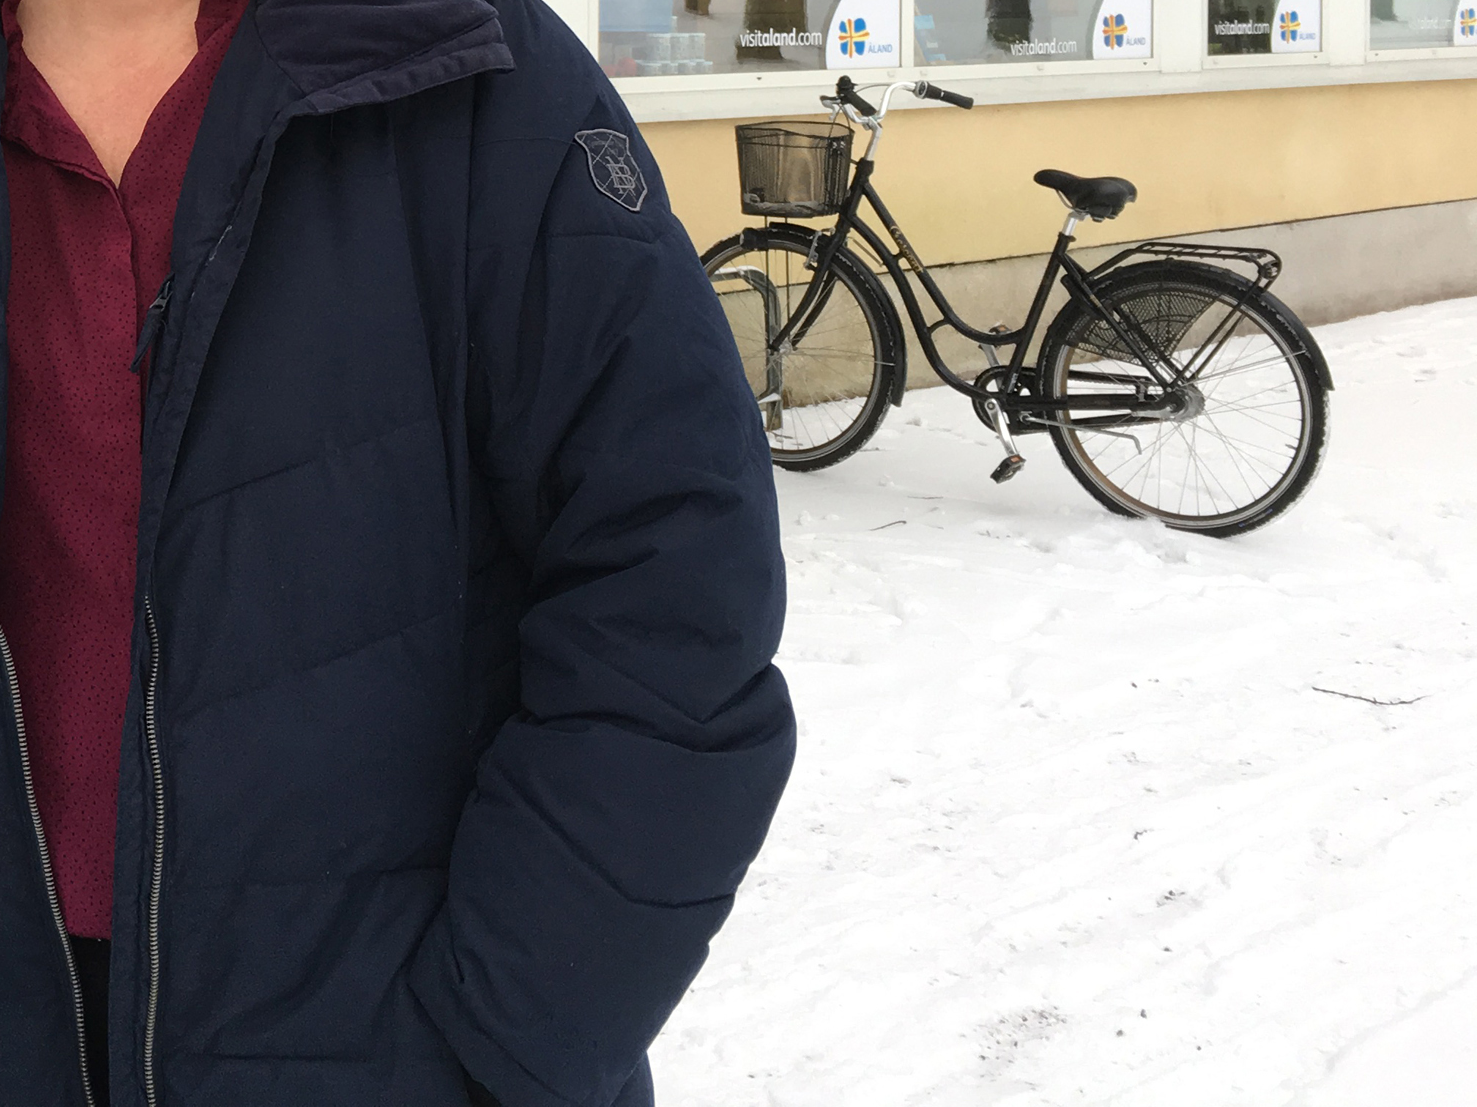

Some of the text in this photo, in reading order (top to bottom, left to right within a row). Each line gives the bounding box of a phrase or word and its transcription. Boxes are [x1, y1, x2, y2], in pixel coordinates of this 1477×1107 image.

[1214, 19, 1270, 35] visitaland.com
[739, 27, 823, 48] visitaland.com
[867, 41, 893, 54] ÅLAND
[1010, 37, 1077, 56] visitaland.com
